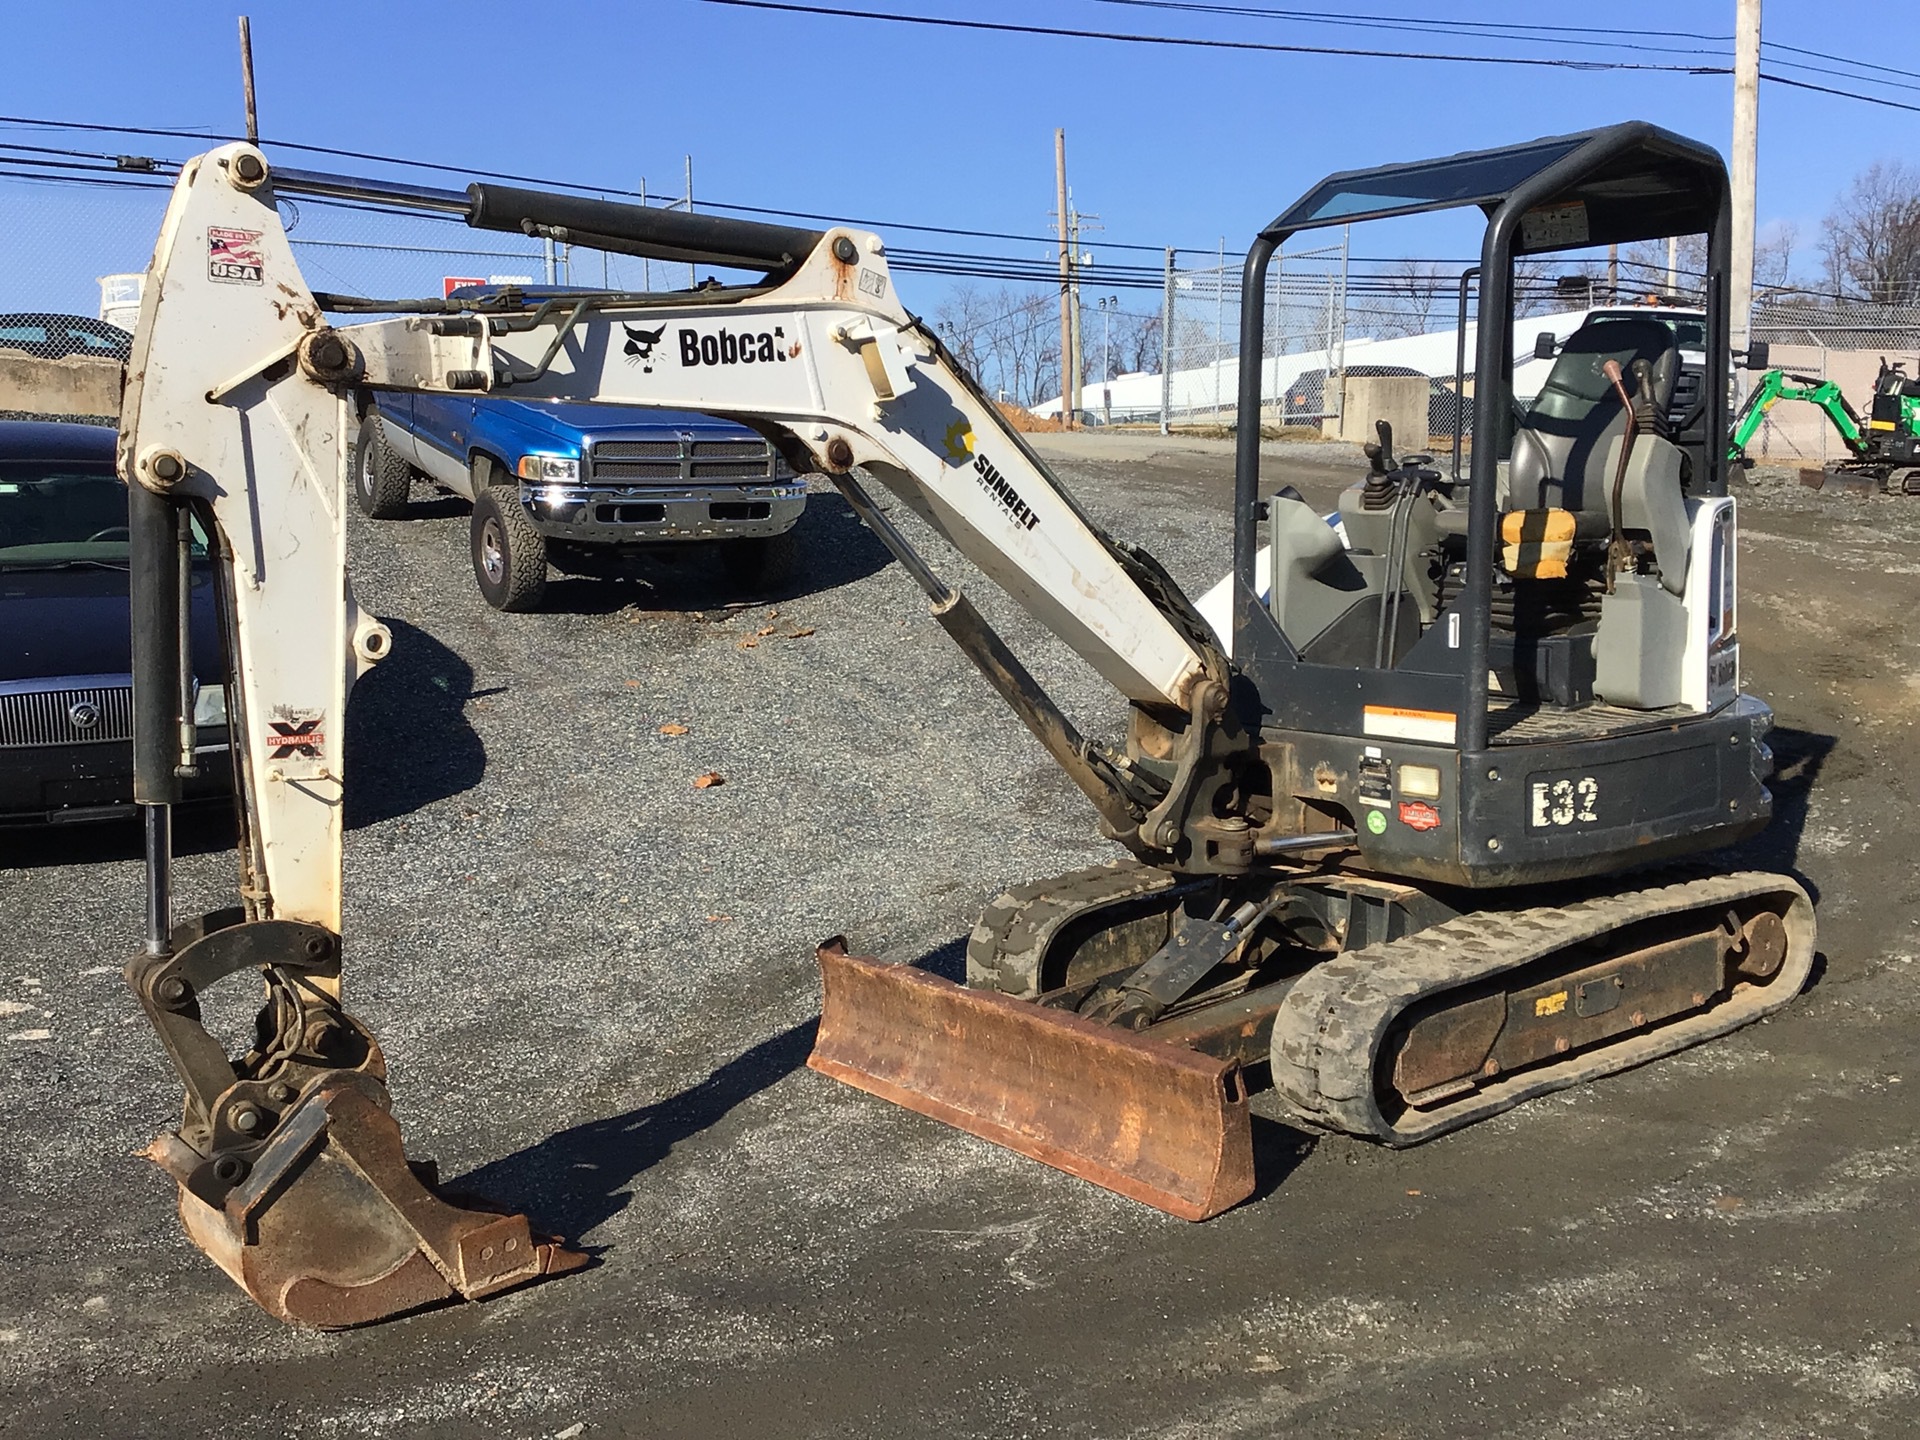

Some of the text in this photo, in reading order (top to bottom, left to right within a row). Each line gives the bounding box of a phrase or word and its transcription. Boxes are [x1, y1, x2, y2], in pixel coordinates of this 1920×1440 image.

[212, 263, 258, 279] USA
[679, 326, 786, 367] Bobcat
[973, 453, 1041, 531] SUNBELT
[976, 476, 1024, 530] RENTALS
[267, 734, 323, 746] HYDRAULIC
[1532, 777, 1598, 827] E32
